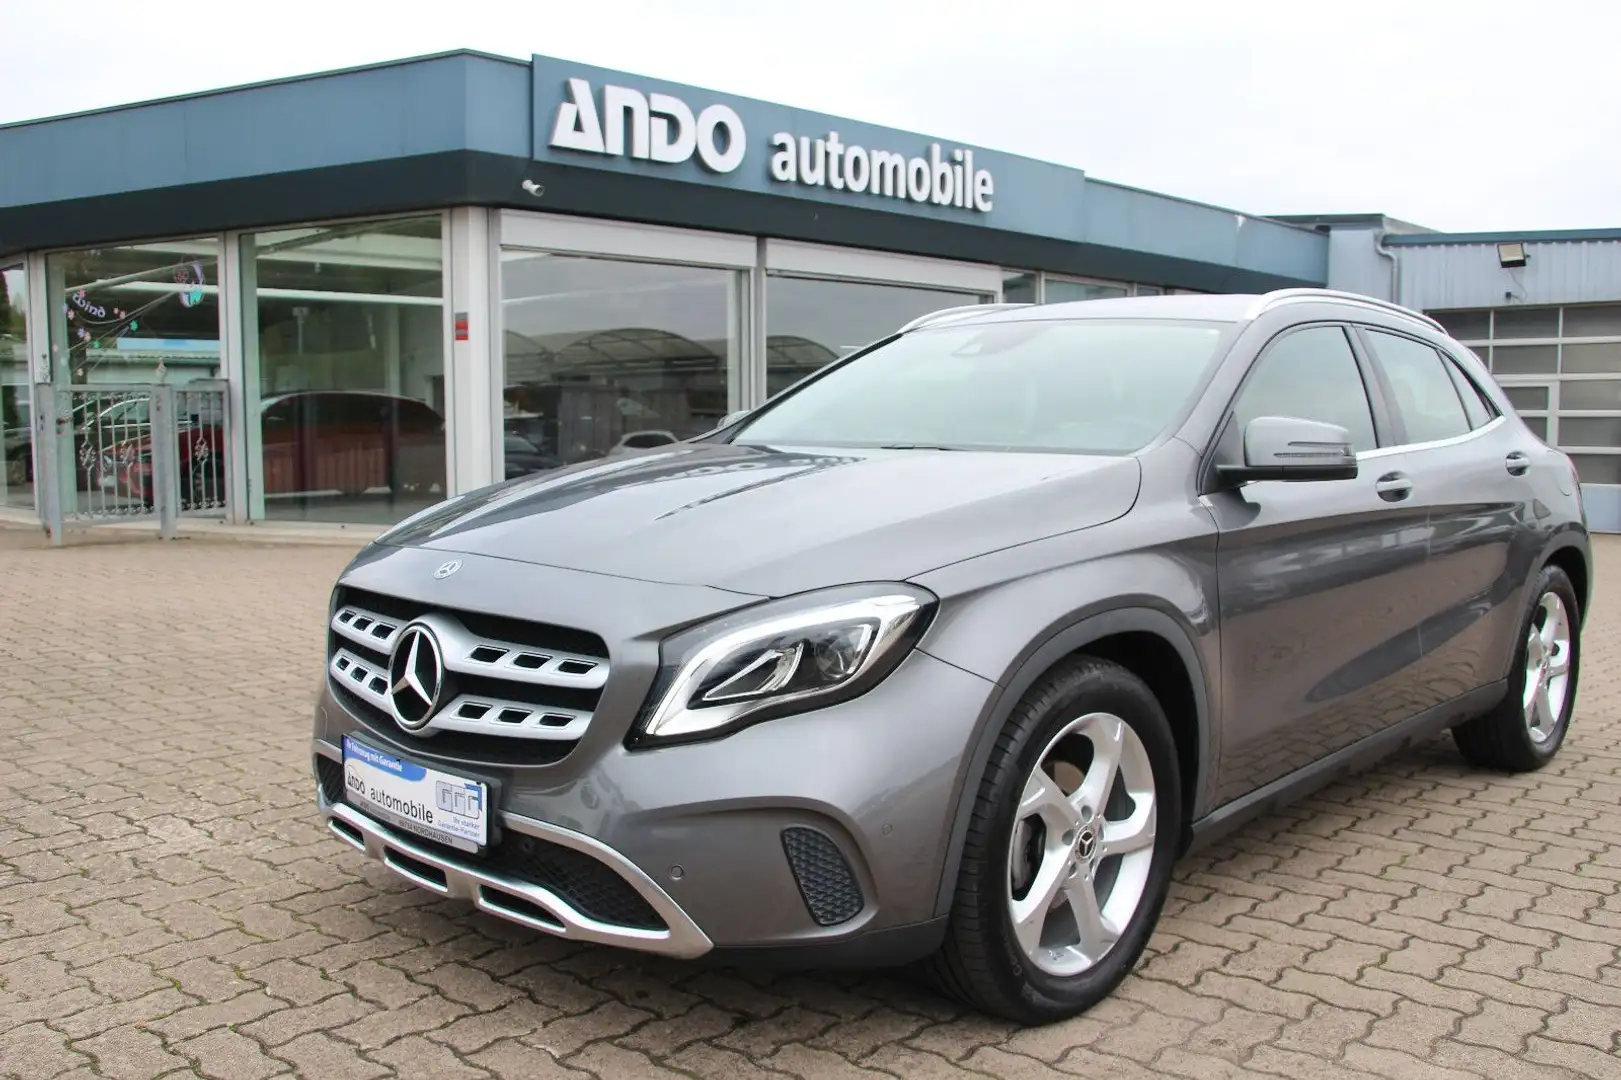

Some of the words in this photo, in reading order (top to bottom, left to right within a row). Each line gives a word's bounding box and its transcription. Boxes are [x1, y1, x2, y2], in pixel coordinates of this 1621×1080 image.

[549, 77, 747, 174] ANDO
[771, 130, 994, 213] automobile
[370, 787, 434, 824] automobile
[413, 825, 453, 844] NORDHAUSEN
